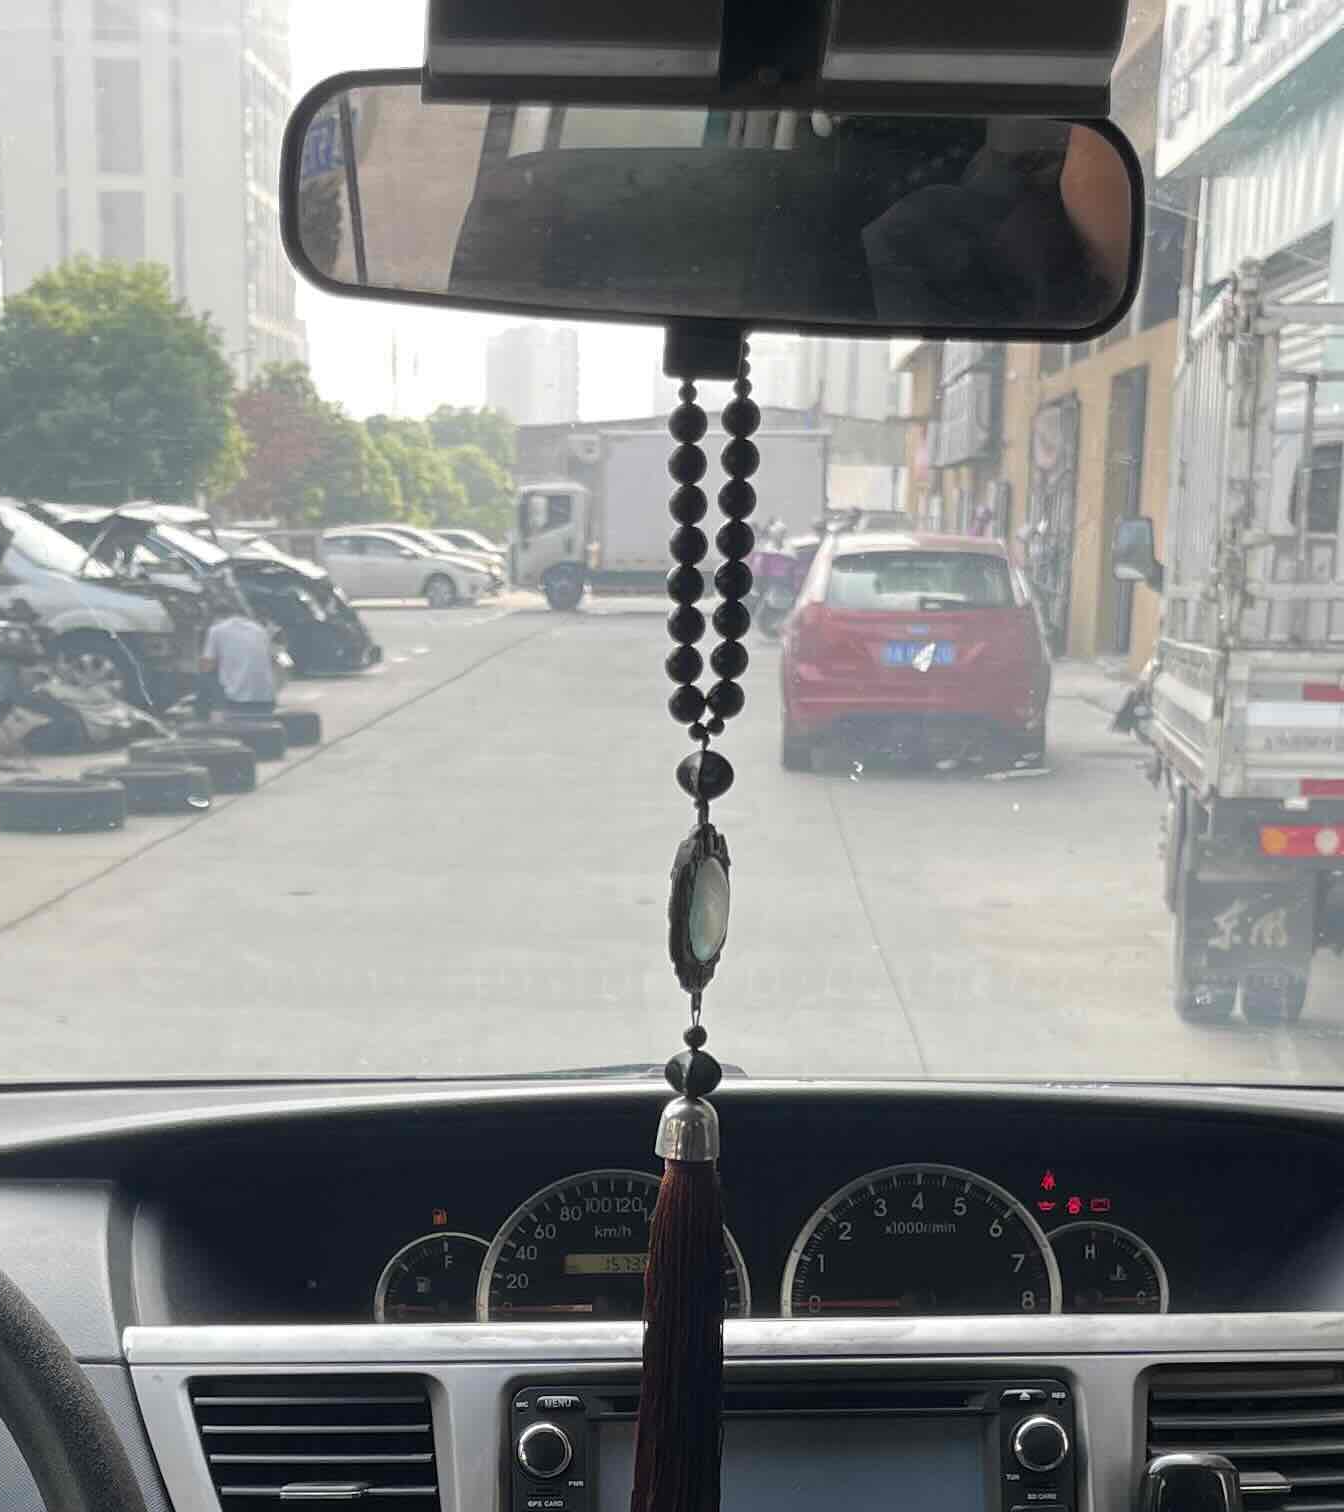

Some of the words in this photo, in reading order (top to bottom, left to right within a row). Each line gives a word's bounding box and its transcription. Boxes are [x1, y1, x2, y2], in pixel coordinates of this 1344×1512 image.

[585, 1198, 612, 1213] 100
[615, 1198, 643, 1213] 120
[873, 1198, 888, 1217] 3
[911, 1191, 925, 1211] 4
[953, 1197, 967, 1216] 5
[559, 1206, 582, 1221] 80
[534, 1224, 556, 1239] 60
[594, 1225, 632, 1239] km/h
[838, 1222, 853, 1240] 2
[989, 1219, 1004, 1238] 6
[515, 1246, 537, 1260] 40
[1085, 1244, 1096, 1259] H
[444, 1256, 453, 1269] F
[1011, 1254, 1025, 1273] 7
[506, 1273, 529, 1289] 20
[1021, 1290, 1035, 1310] 8
[544, 1399, 572, 1408] MENU
